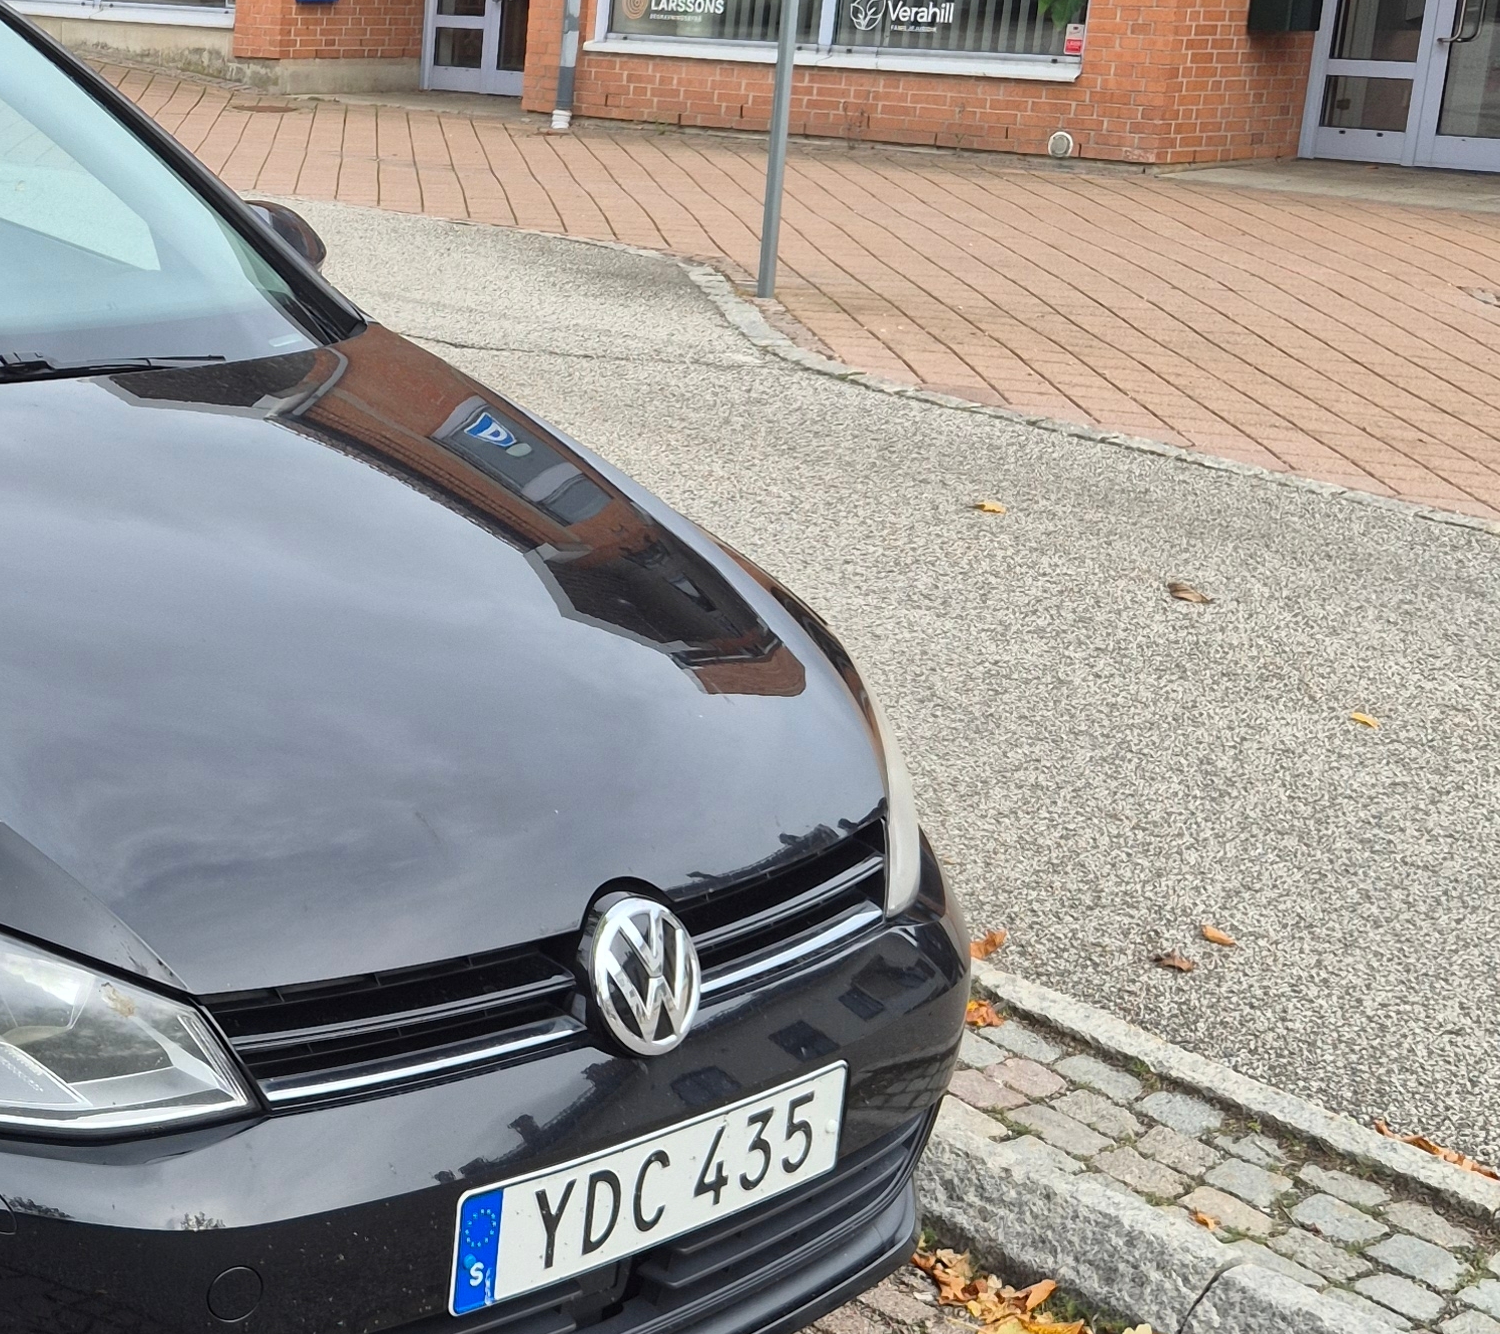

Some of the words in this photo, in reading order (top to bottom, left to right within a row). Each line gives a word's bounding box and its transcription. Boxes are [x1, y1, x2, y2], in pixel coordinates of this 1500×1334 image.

[887, 0, 955, 24] Verahill
[534, 1149, 671, 1269] YDC
[693, 1090, 815, 1206] 435
[469, 1262, 484, 1286] S
